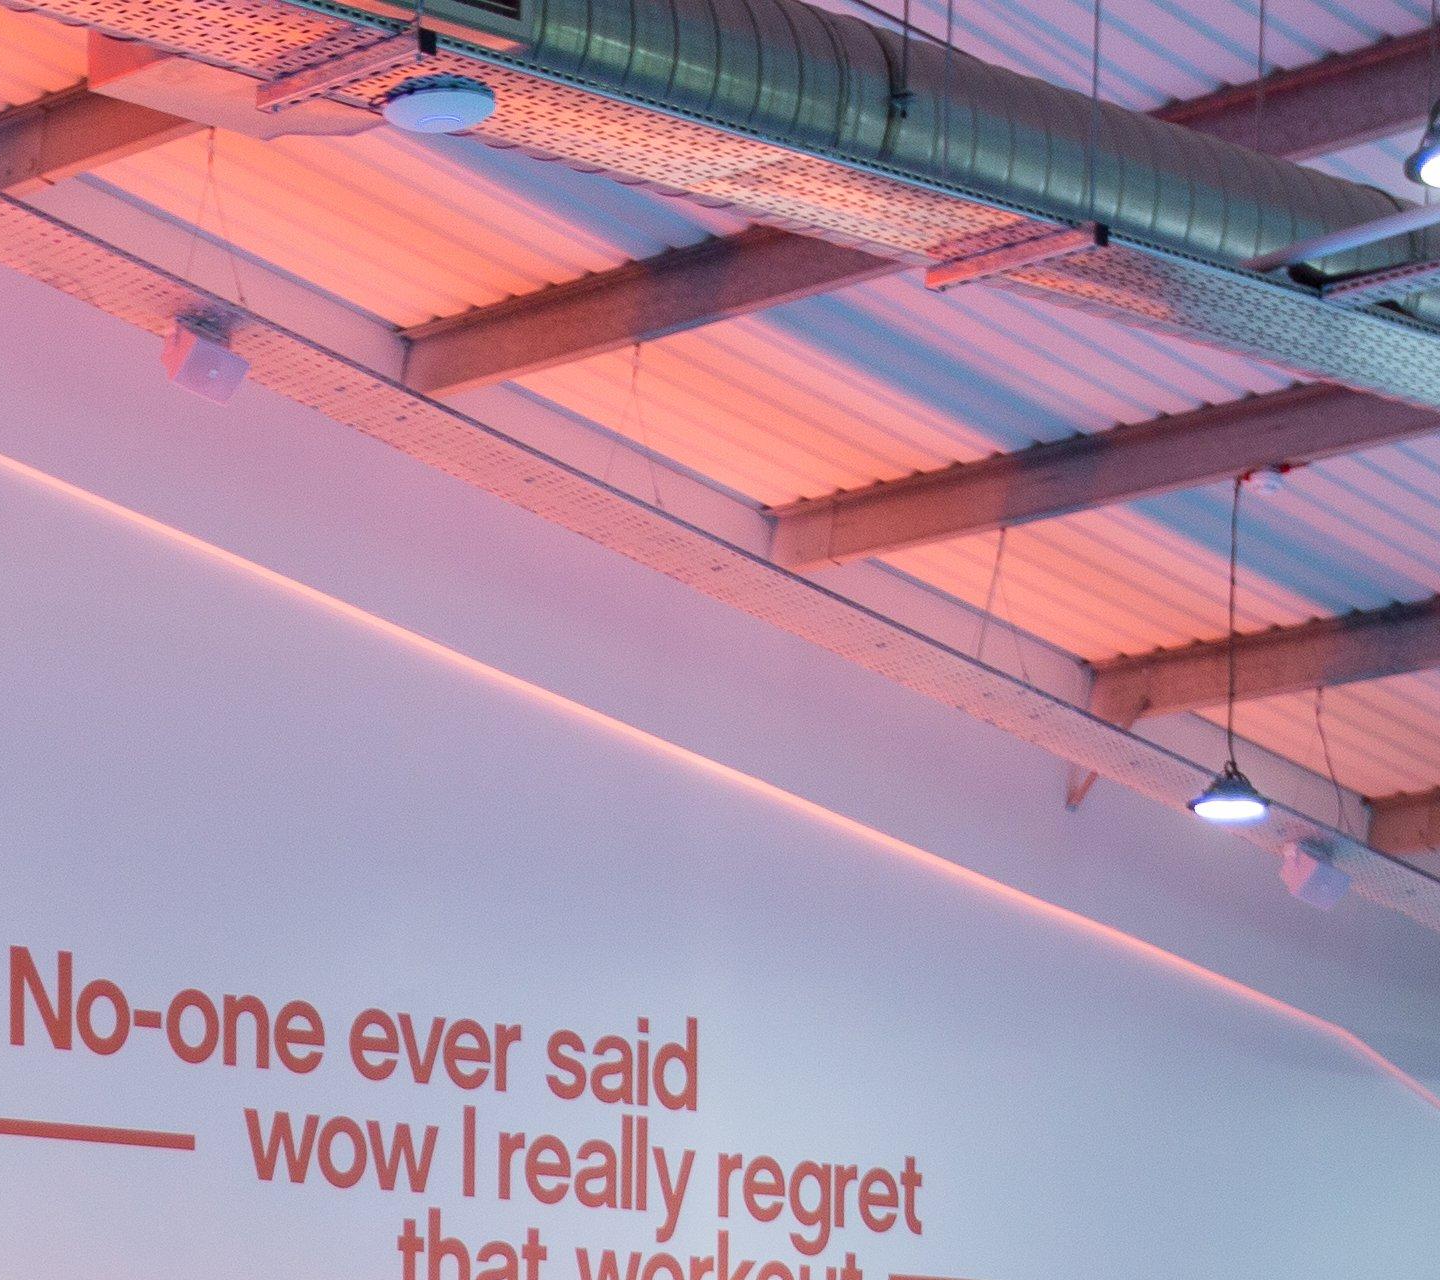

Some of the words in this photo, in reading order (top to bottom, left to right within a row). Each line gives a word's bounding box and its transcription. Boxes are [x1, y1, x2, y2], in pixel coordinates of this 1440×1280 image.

[9, 945, 325, 1075] No-one
[349, 1008, 522, 1093] ever
[546, 1016, 699, 1111] said
[243, 1106, 439, 1193] wow
[462, 1104, 476, 1197] I
[497, 1115, 695, 1242] really
[718, 1154, 923, 1256] regret
